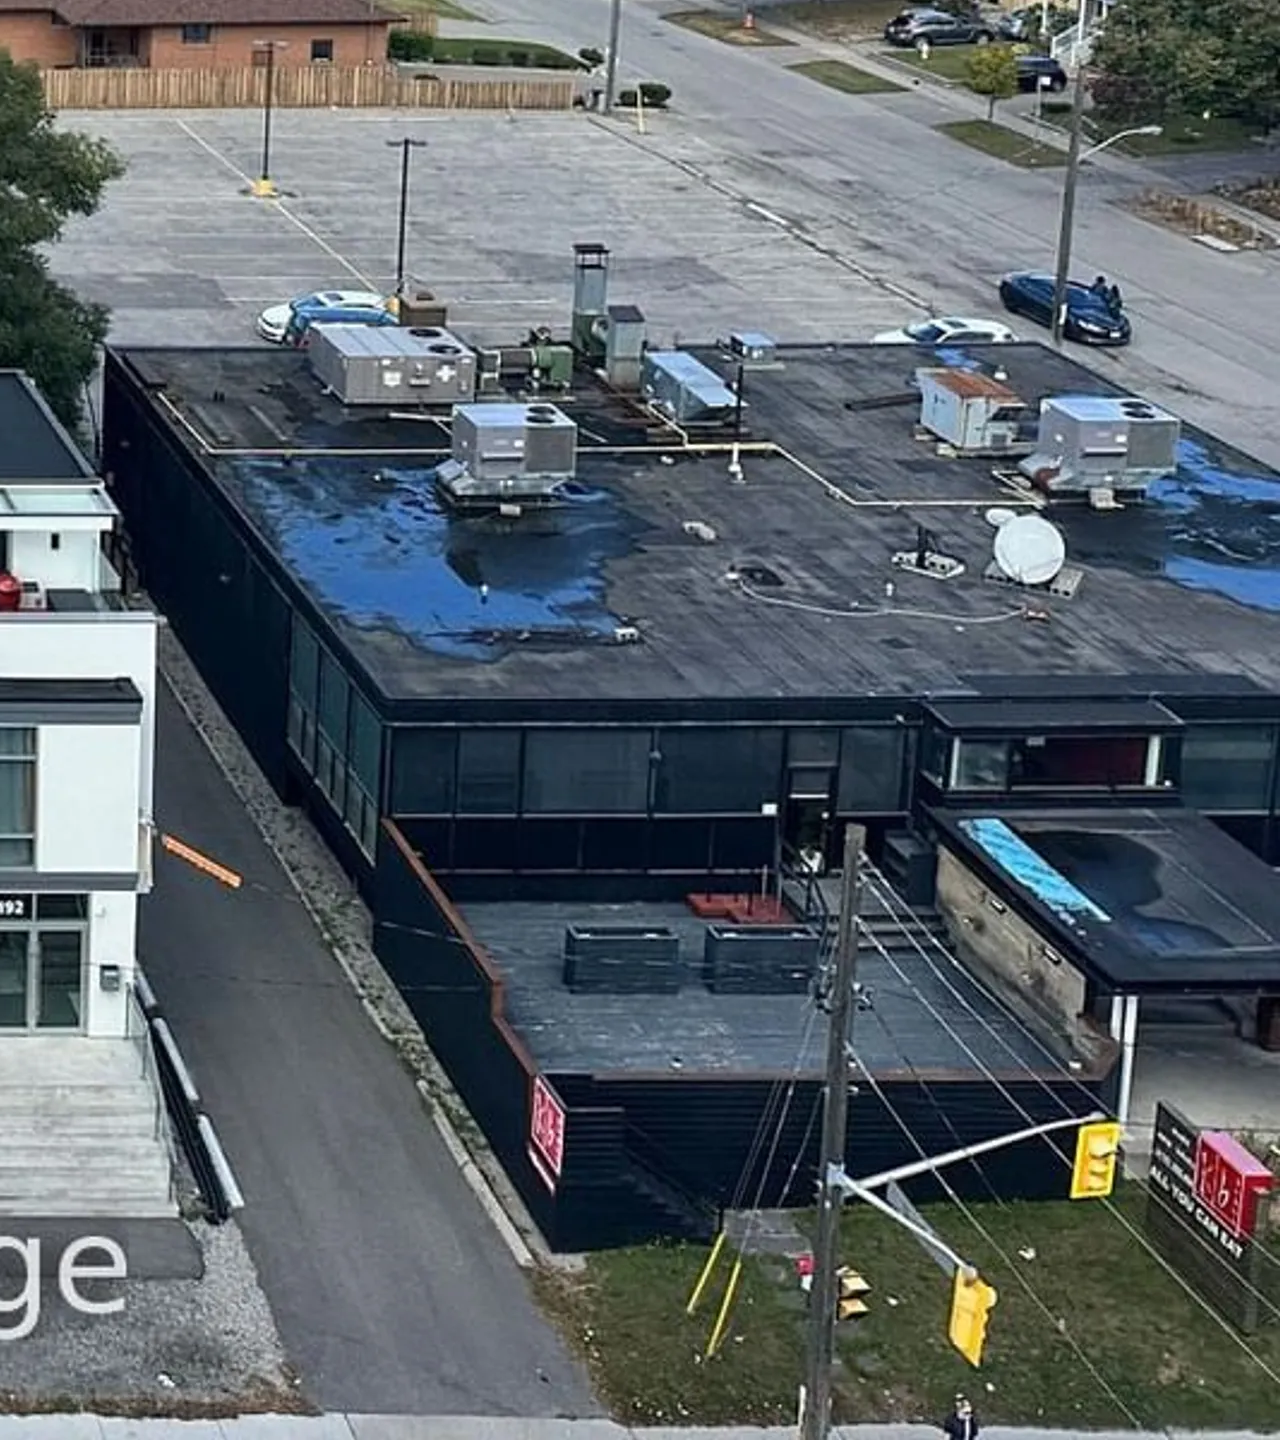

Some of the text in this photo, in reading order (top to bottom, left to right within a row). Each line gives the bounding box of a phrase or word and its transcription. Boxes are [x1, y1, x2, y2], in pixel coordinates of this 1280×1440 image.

[1149, 1165, 1244, 1259] ALL YOU CAN EAT
